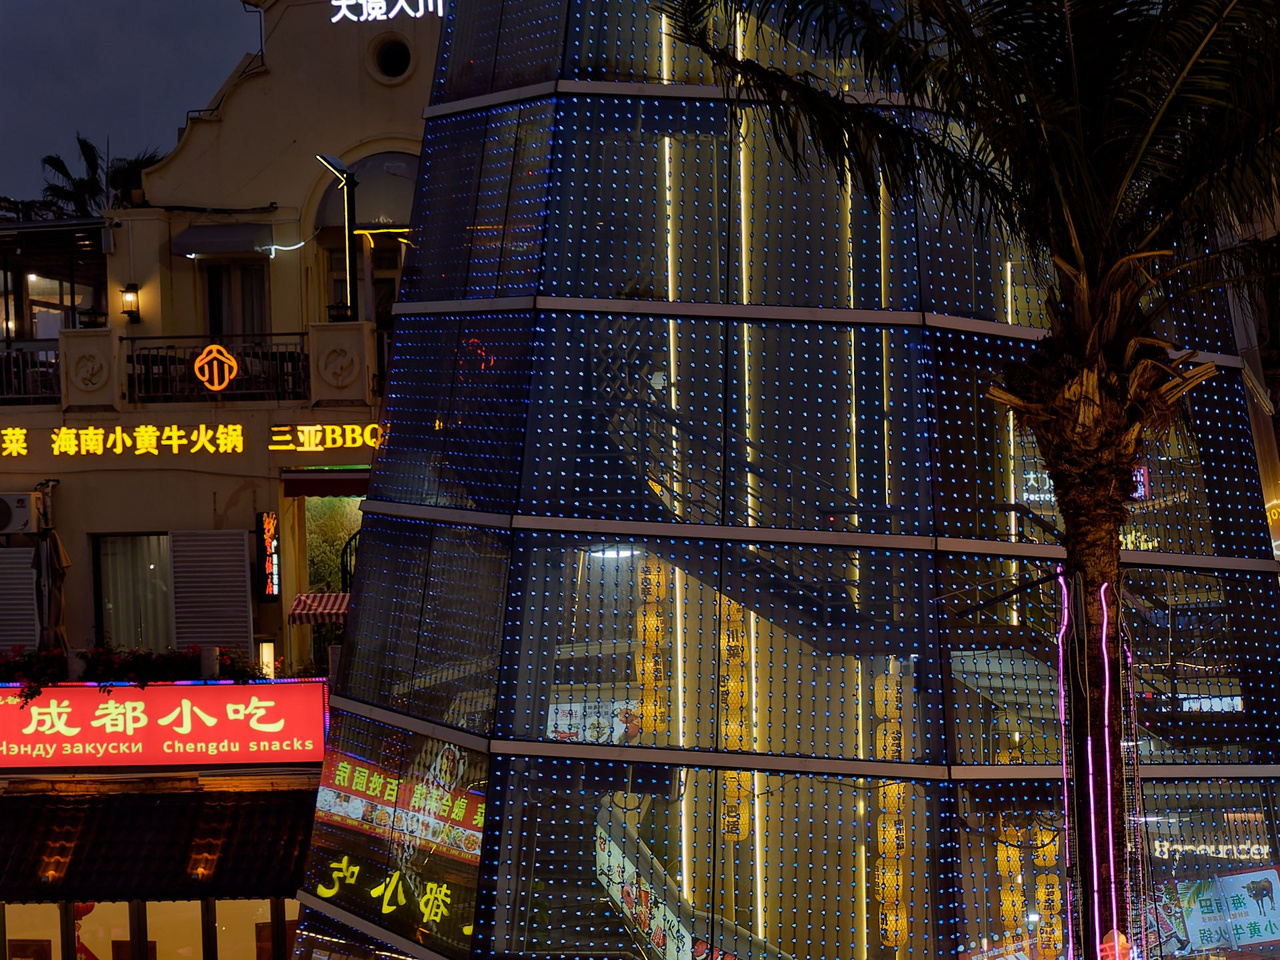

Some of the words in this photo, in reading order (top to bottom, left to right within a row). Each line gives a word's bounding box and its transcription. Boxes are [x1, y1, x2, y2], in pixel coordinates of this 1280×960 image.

[0, 427, 28, 457] 菜
[51, 424, 245, 457] 海南小黄牛火锅
[22, 695, 285, 736] 成都小吃
[61, 741, 144, 756] закуски
[162, 739, 241, 755] Chengdu
[249, 736, 314, 751] snacks
